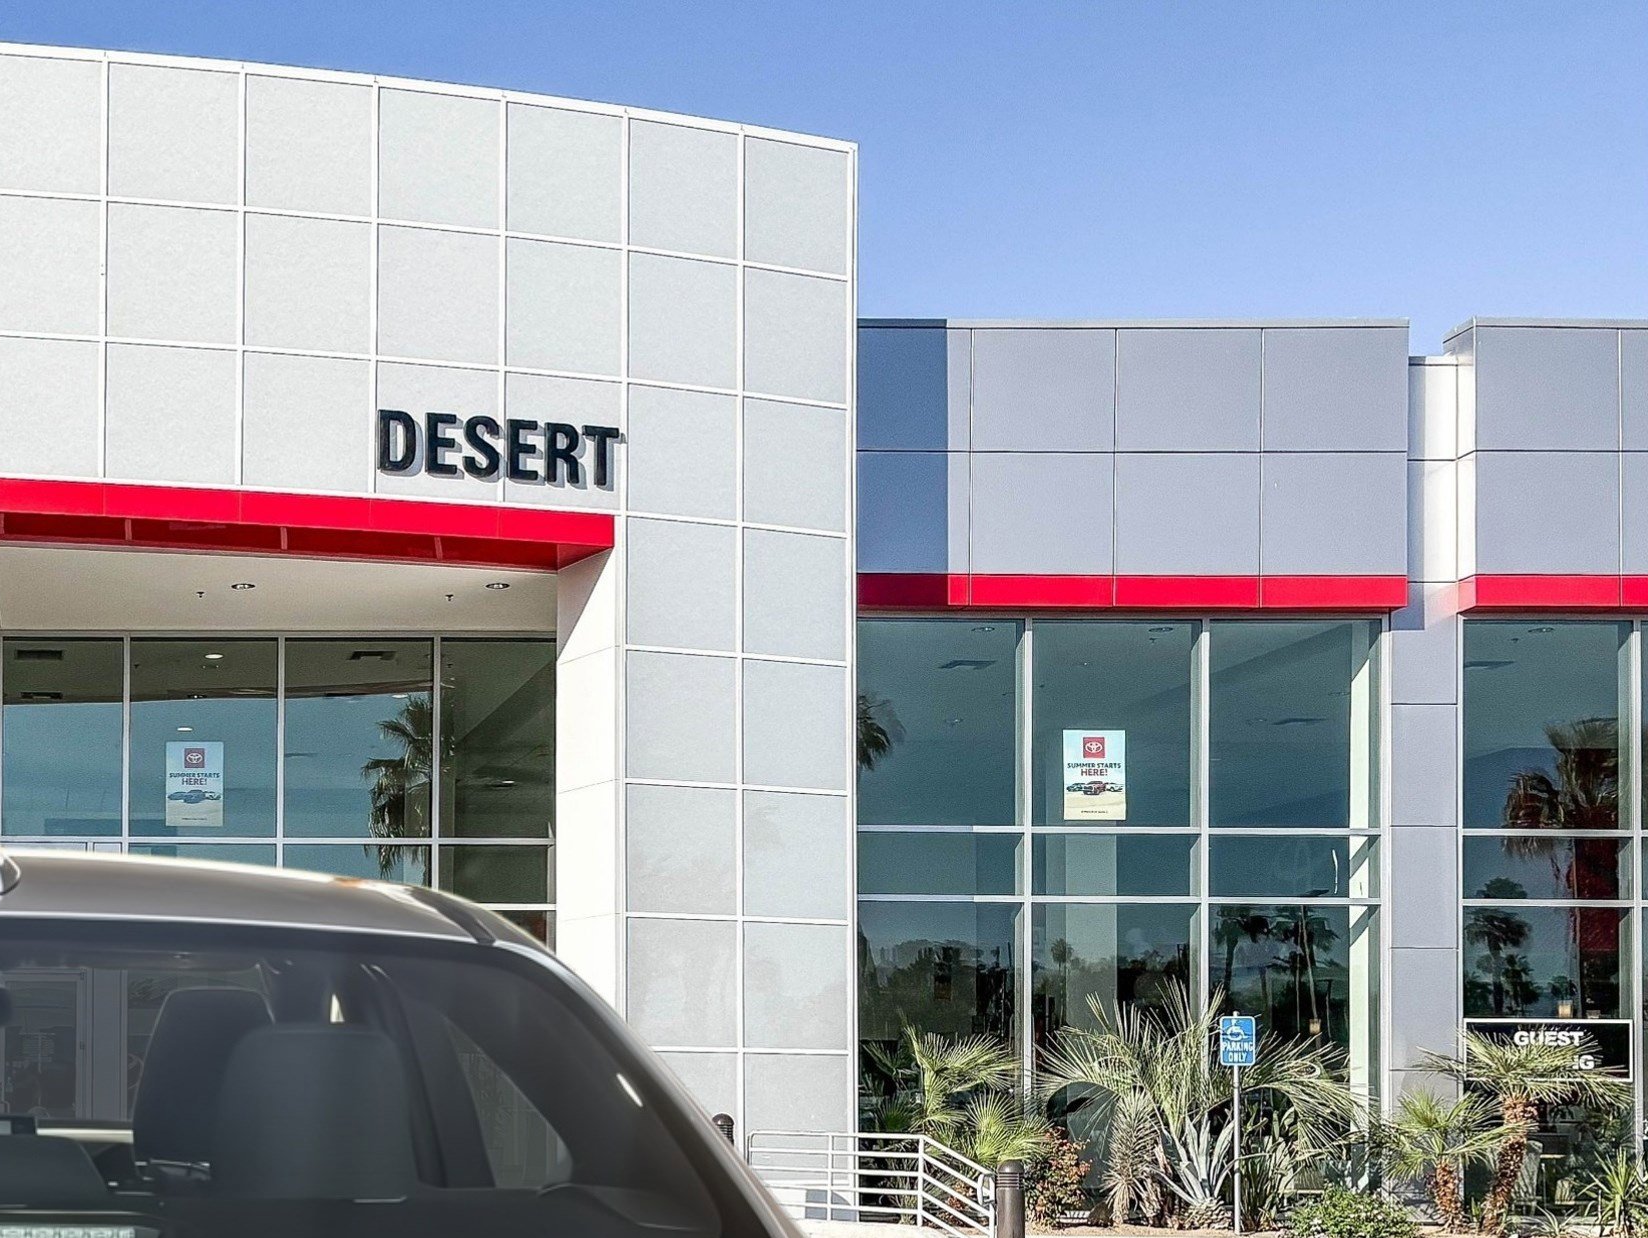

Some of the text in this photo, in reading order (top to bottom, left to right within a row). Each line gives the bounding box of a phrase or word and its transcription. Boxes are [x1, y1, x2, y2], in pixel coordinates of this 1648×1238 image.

[377, 409, 619, 486] DESERT
[1080, 769, 1108, 777] HERE!
[181, 778, 208, 786] HERE!
[1513, 1030, 1584, 1046] GUEST
[1222, 1041, 1254, 1051] PARKING
[1228, 1051, 1248, 1062] ONLY
